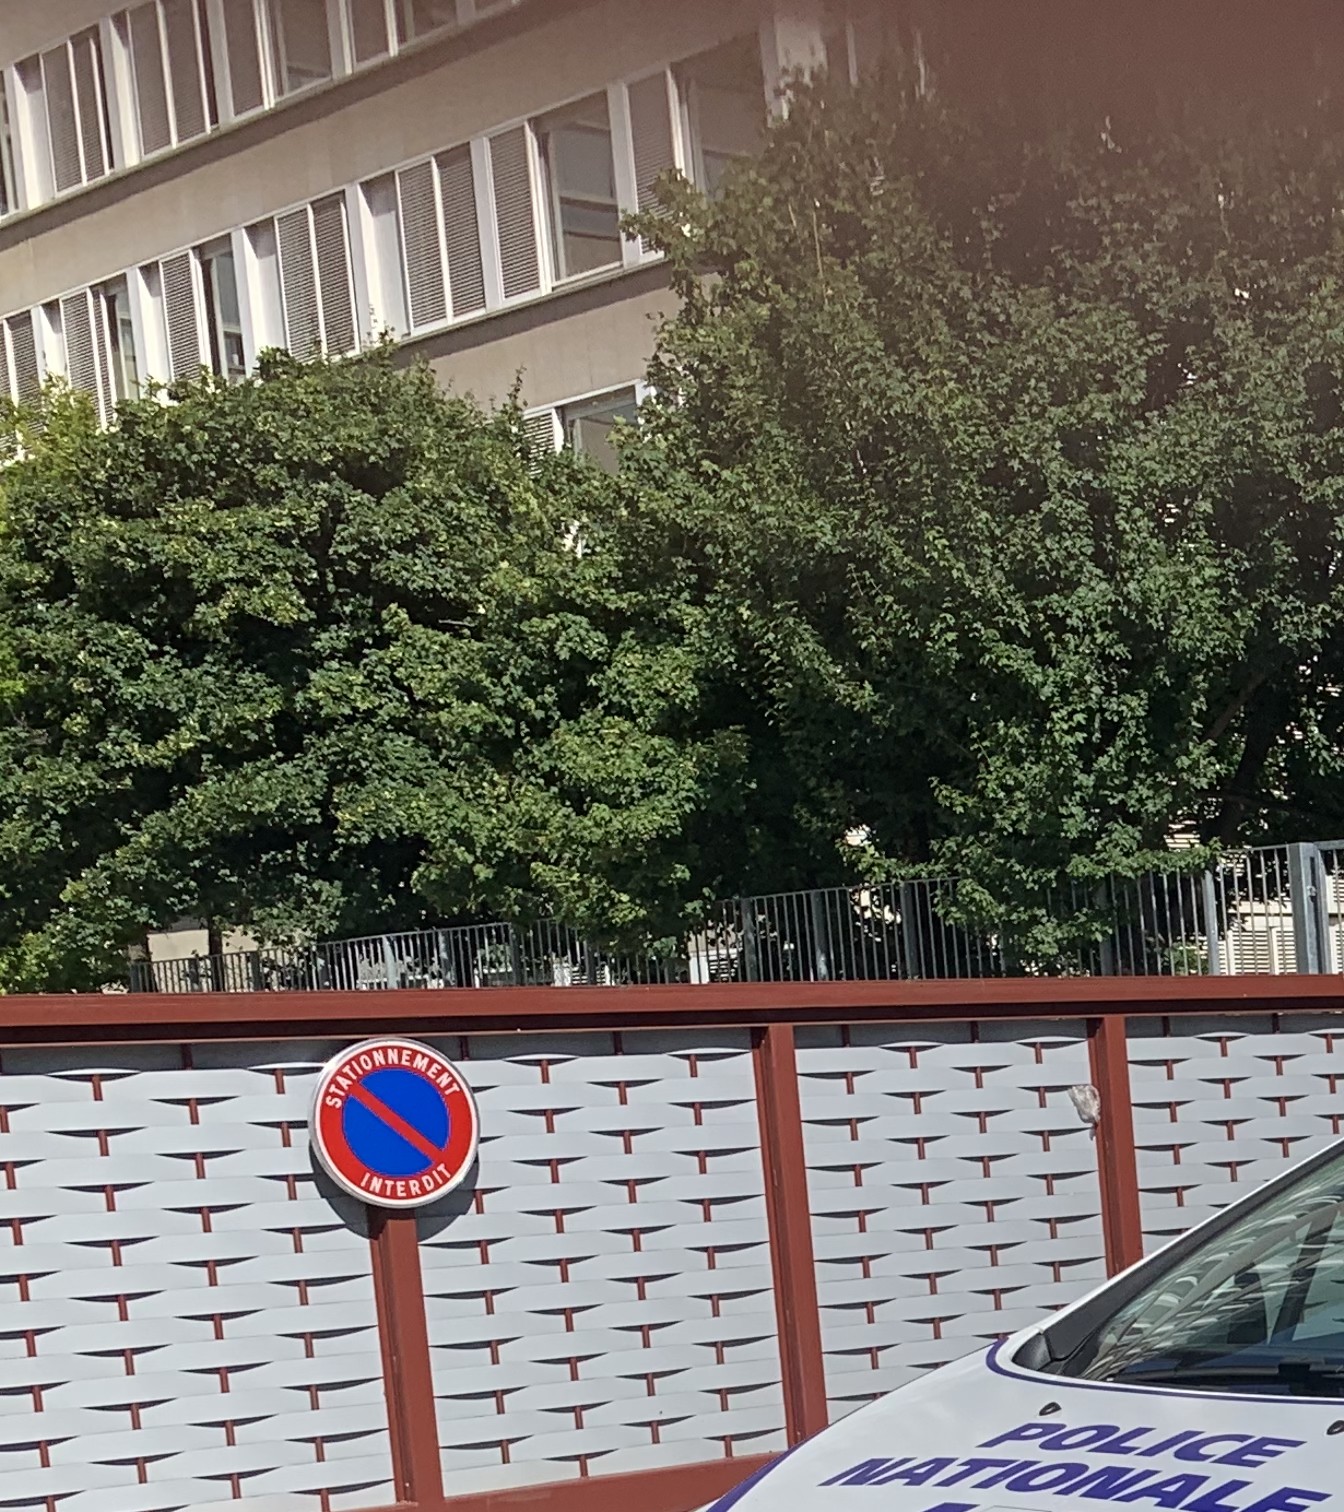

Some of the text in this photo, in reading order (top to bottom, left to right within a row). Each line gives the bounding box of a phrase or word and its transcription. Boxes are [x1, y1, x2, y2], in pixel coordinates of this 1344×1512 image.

[326, 1048, 461, 1109] STATIONNEMENT
[360, 1163, 452, 1197] INTERDIT
[975, 1422, 1308, 1468] POLICE
